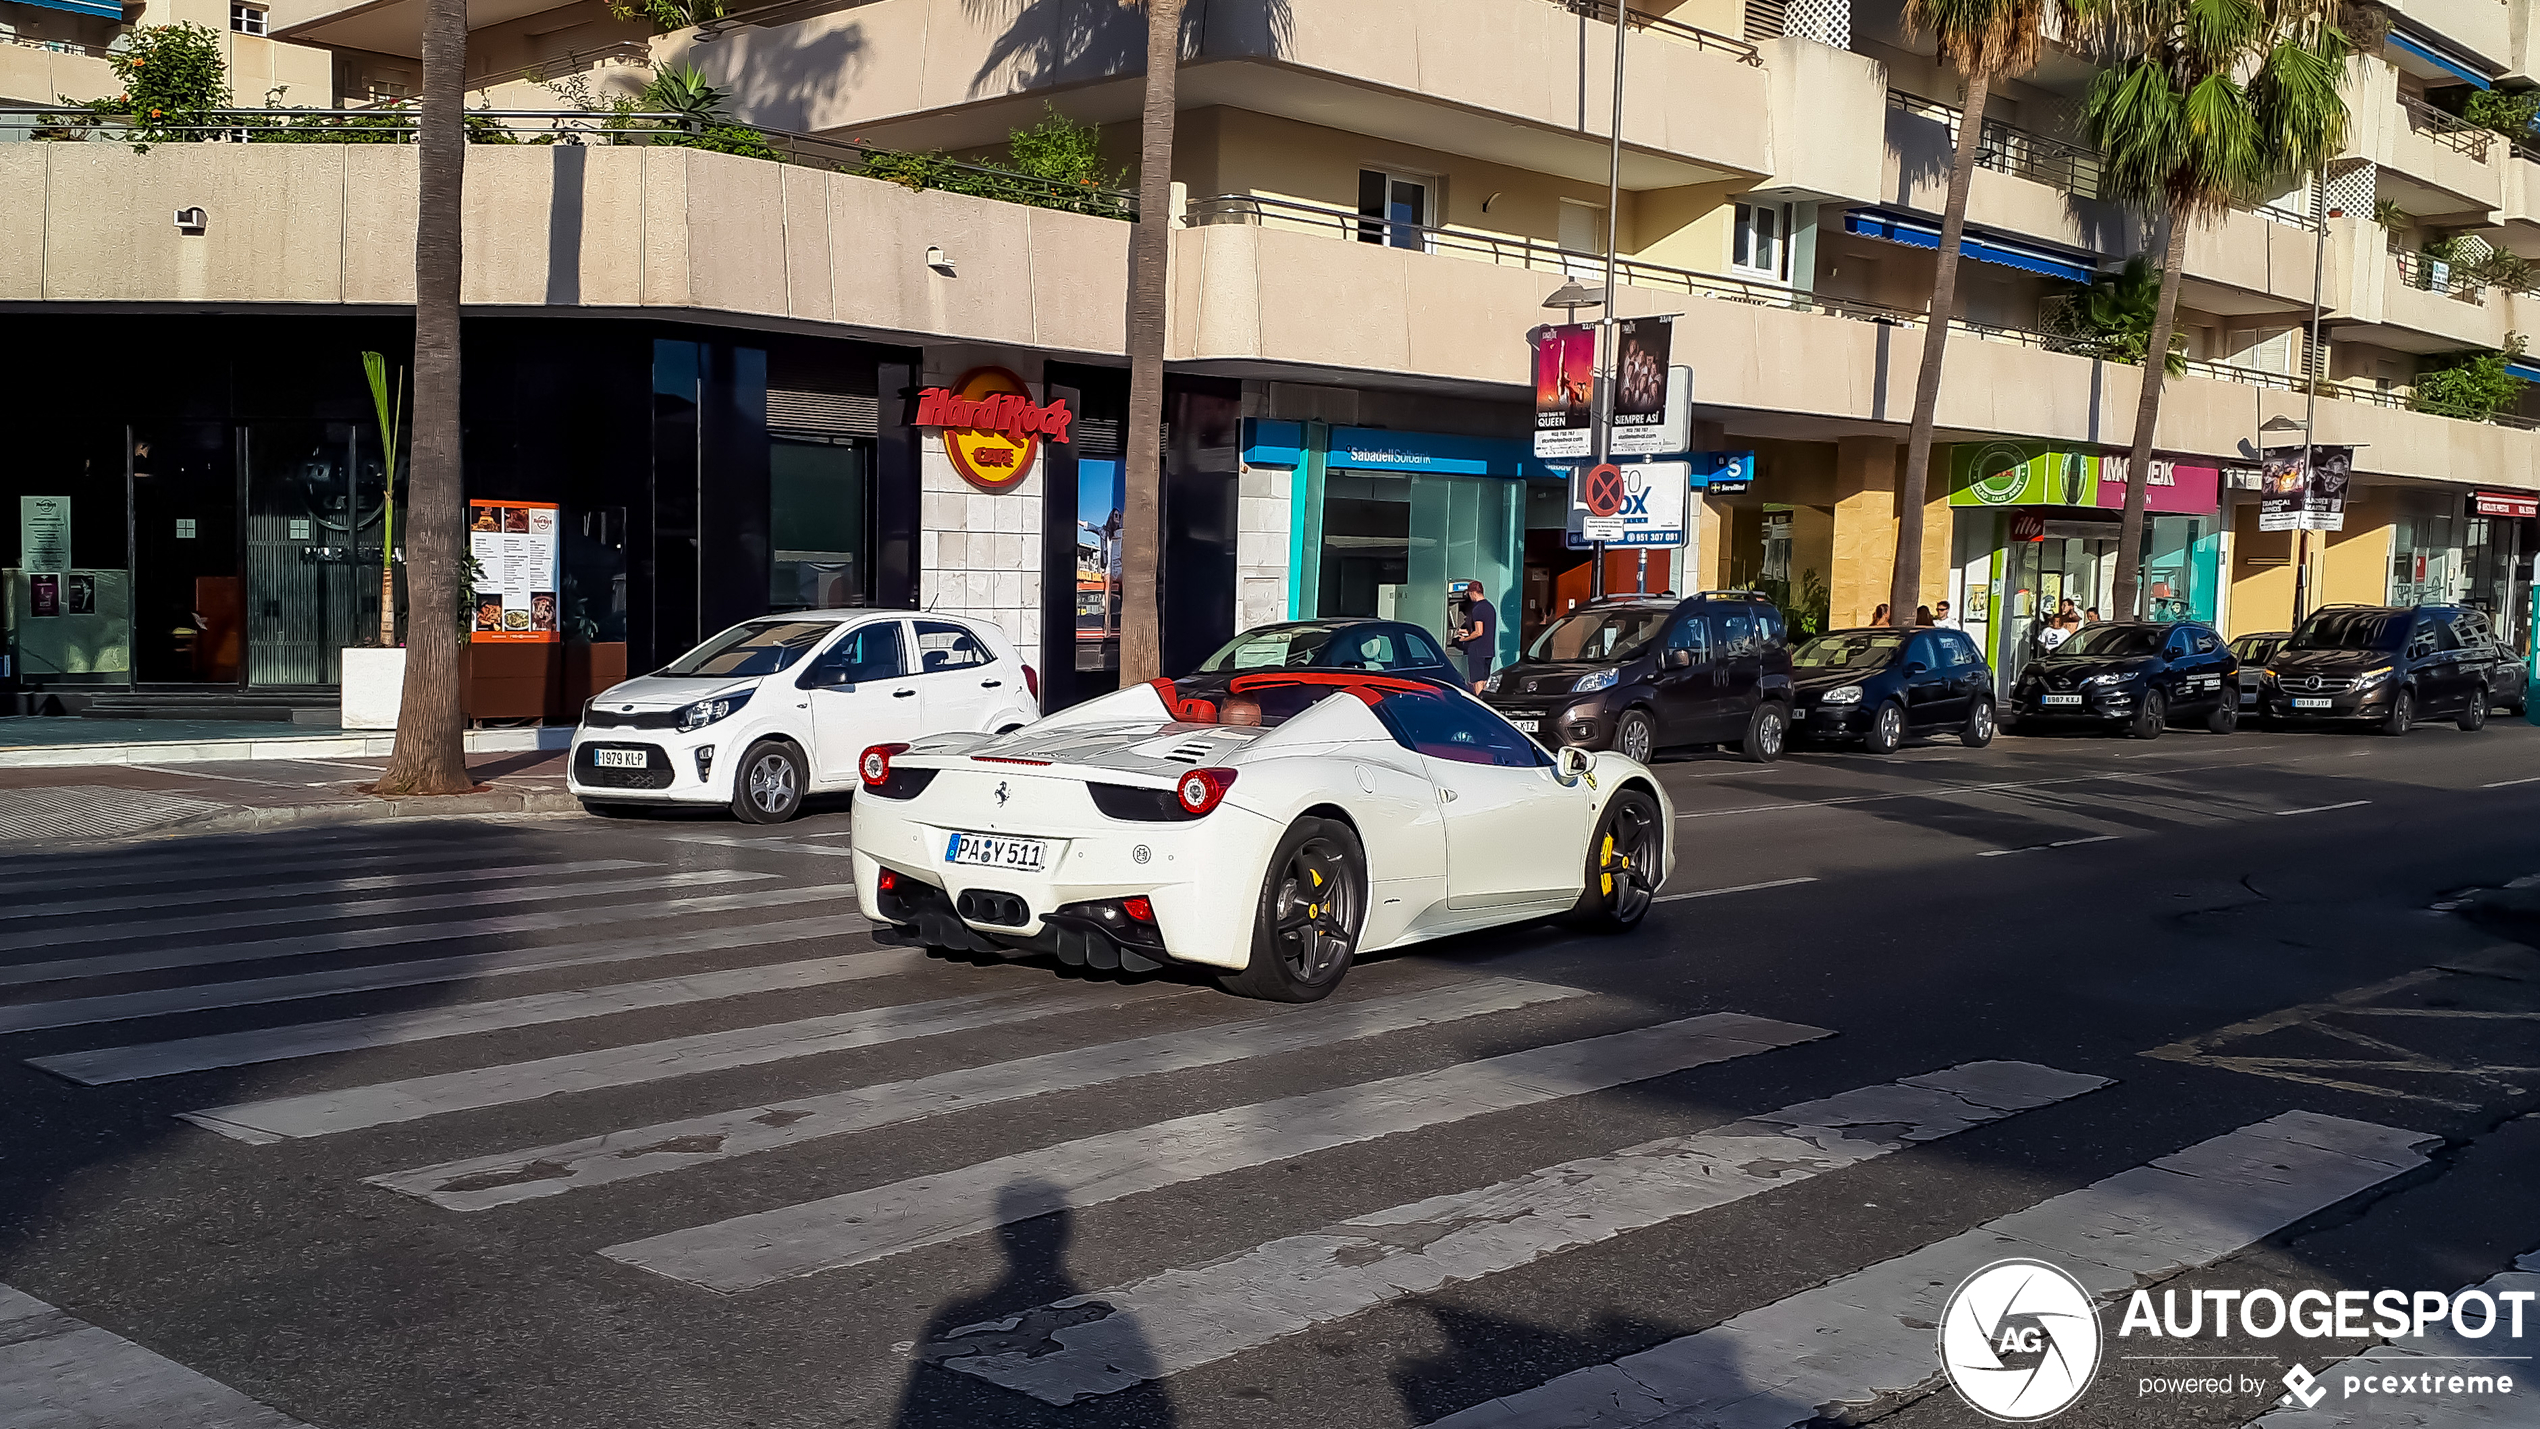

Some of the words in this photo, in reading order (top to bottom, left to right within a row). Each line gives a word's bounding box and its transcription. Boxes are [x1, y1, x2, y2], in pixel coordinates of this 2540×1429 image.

[915, 387, 1000, 429] Hard
[995, 394, 1072, 444] Rock
[1538, 416, 1566, 428] QUEEN
[1615, 414, 1645, 425] SIEMPRE
[1645, 411, 1659, 423] ASÍ
[1727, 456, 1742, 478] S
[2014, 516, 2042, 539] illy
[1650, 533, 1664, 542] 307
[601, 752, 623, 765] 1979
[625, 753, 644, 766] KLP
[957, 838, 980, 860] PA
[994, 841, 1006, 862] Y
[1006, 843, 1040, 867] 511
